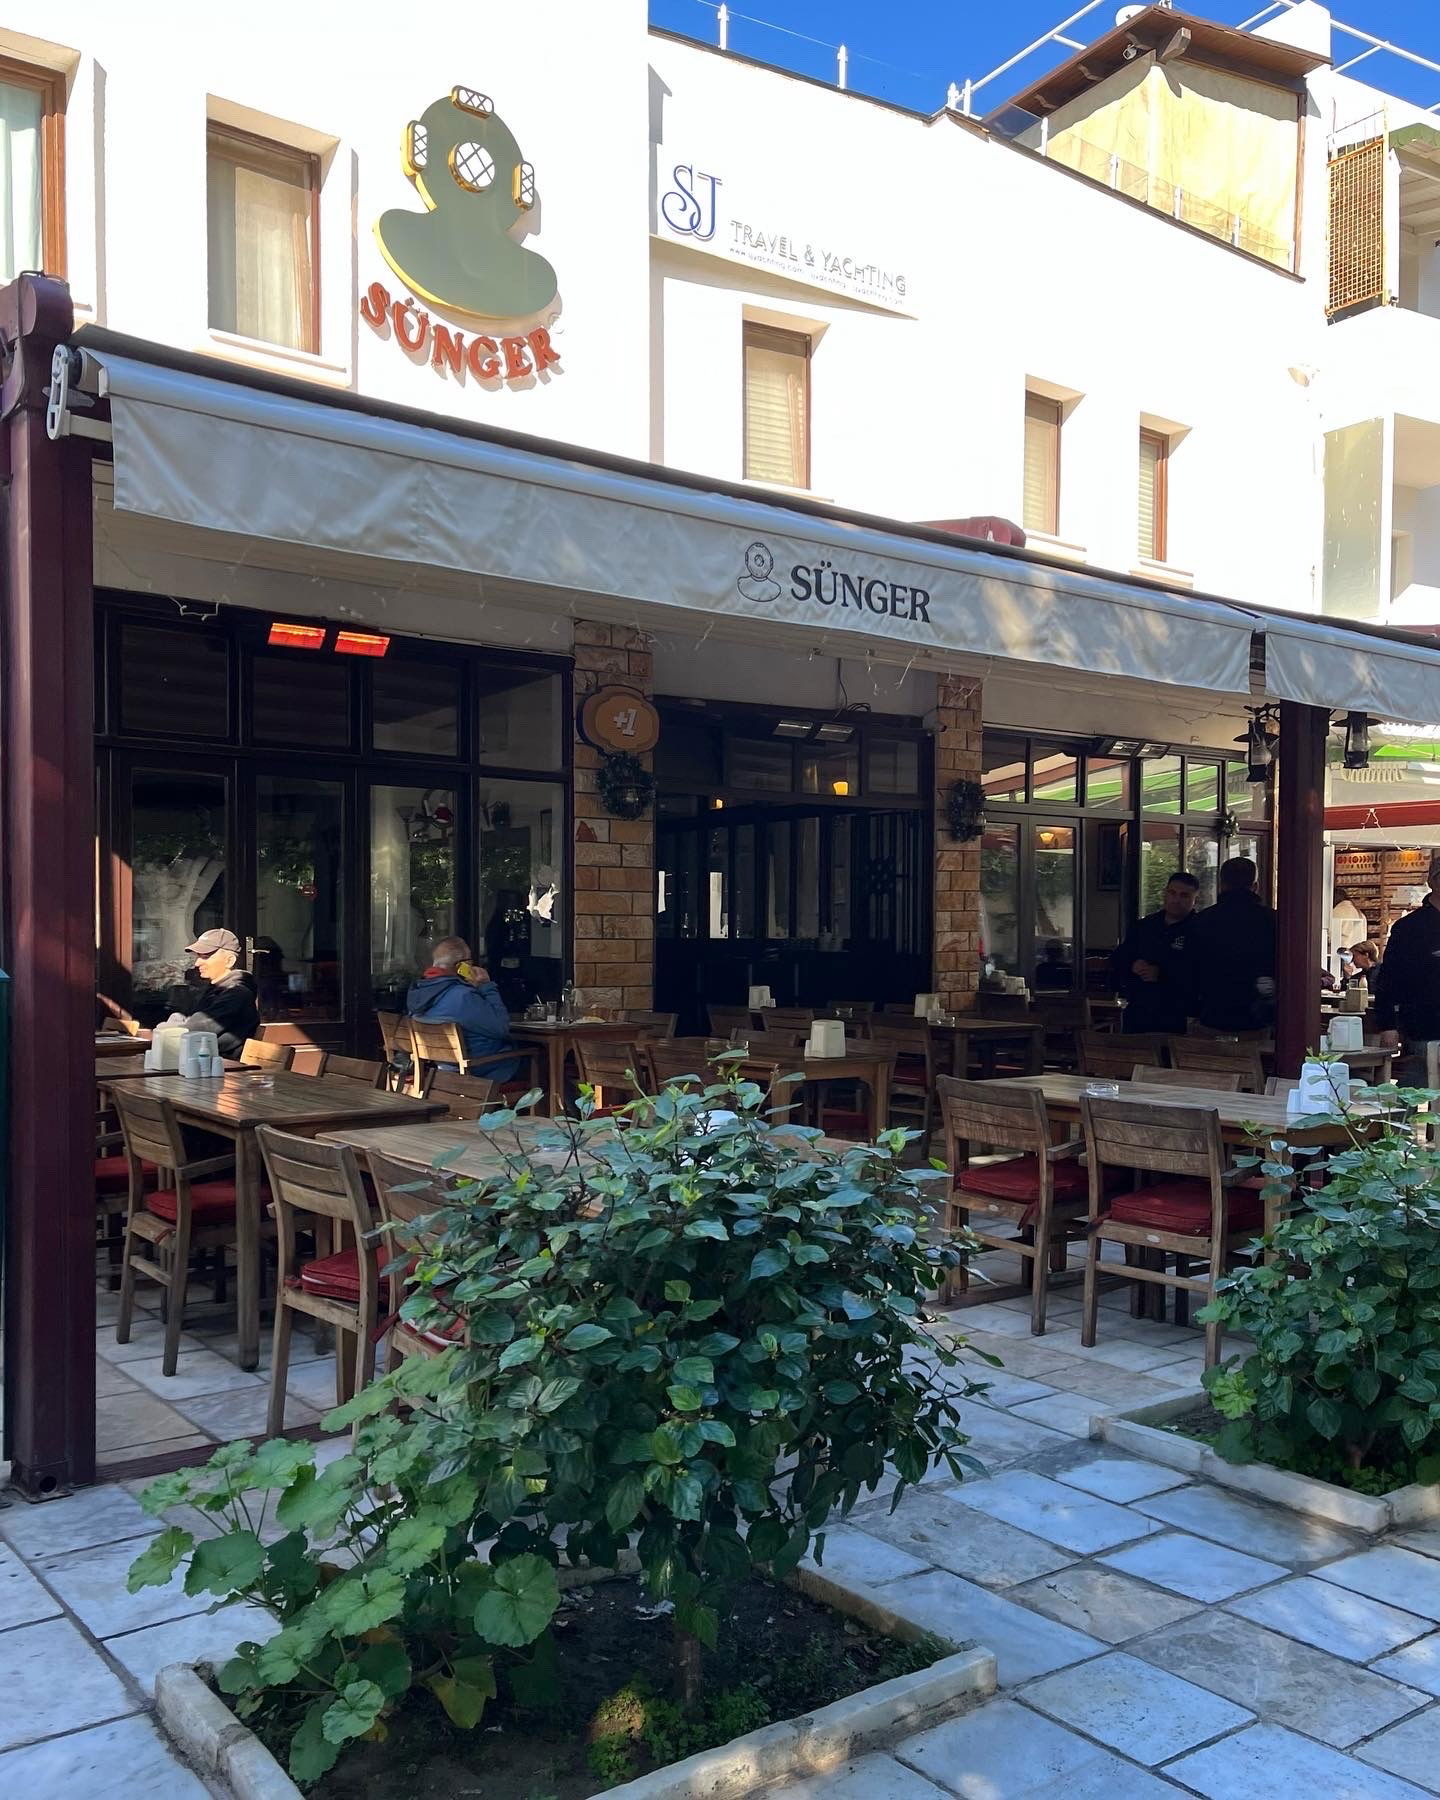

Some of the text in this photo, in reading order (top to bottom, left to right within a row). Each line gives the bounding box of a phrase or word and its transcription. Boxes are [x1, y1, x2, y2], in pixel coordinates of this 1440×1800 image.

[661, 164, 722, 240] SJ
[730, 220, 798, 261] TRAVEL
[804, 244, 815, 267] &
[821, 249, 906, 296] YACHTING
[361, 282, 561, 379] SÜNGER
[790, 560, 931, 623] SÜNGER
